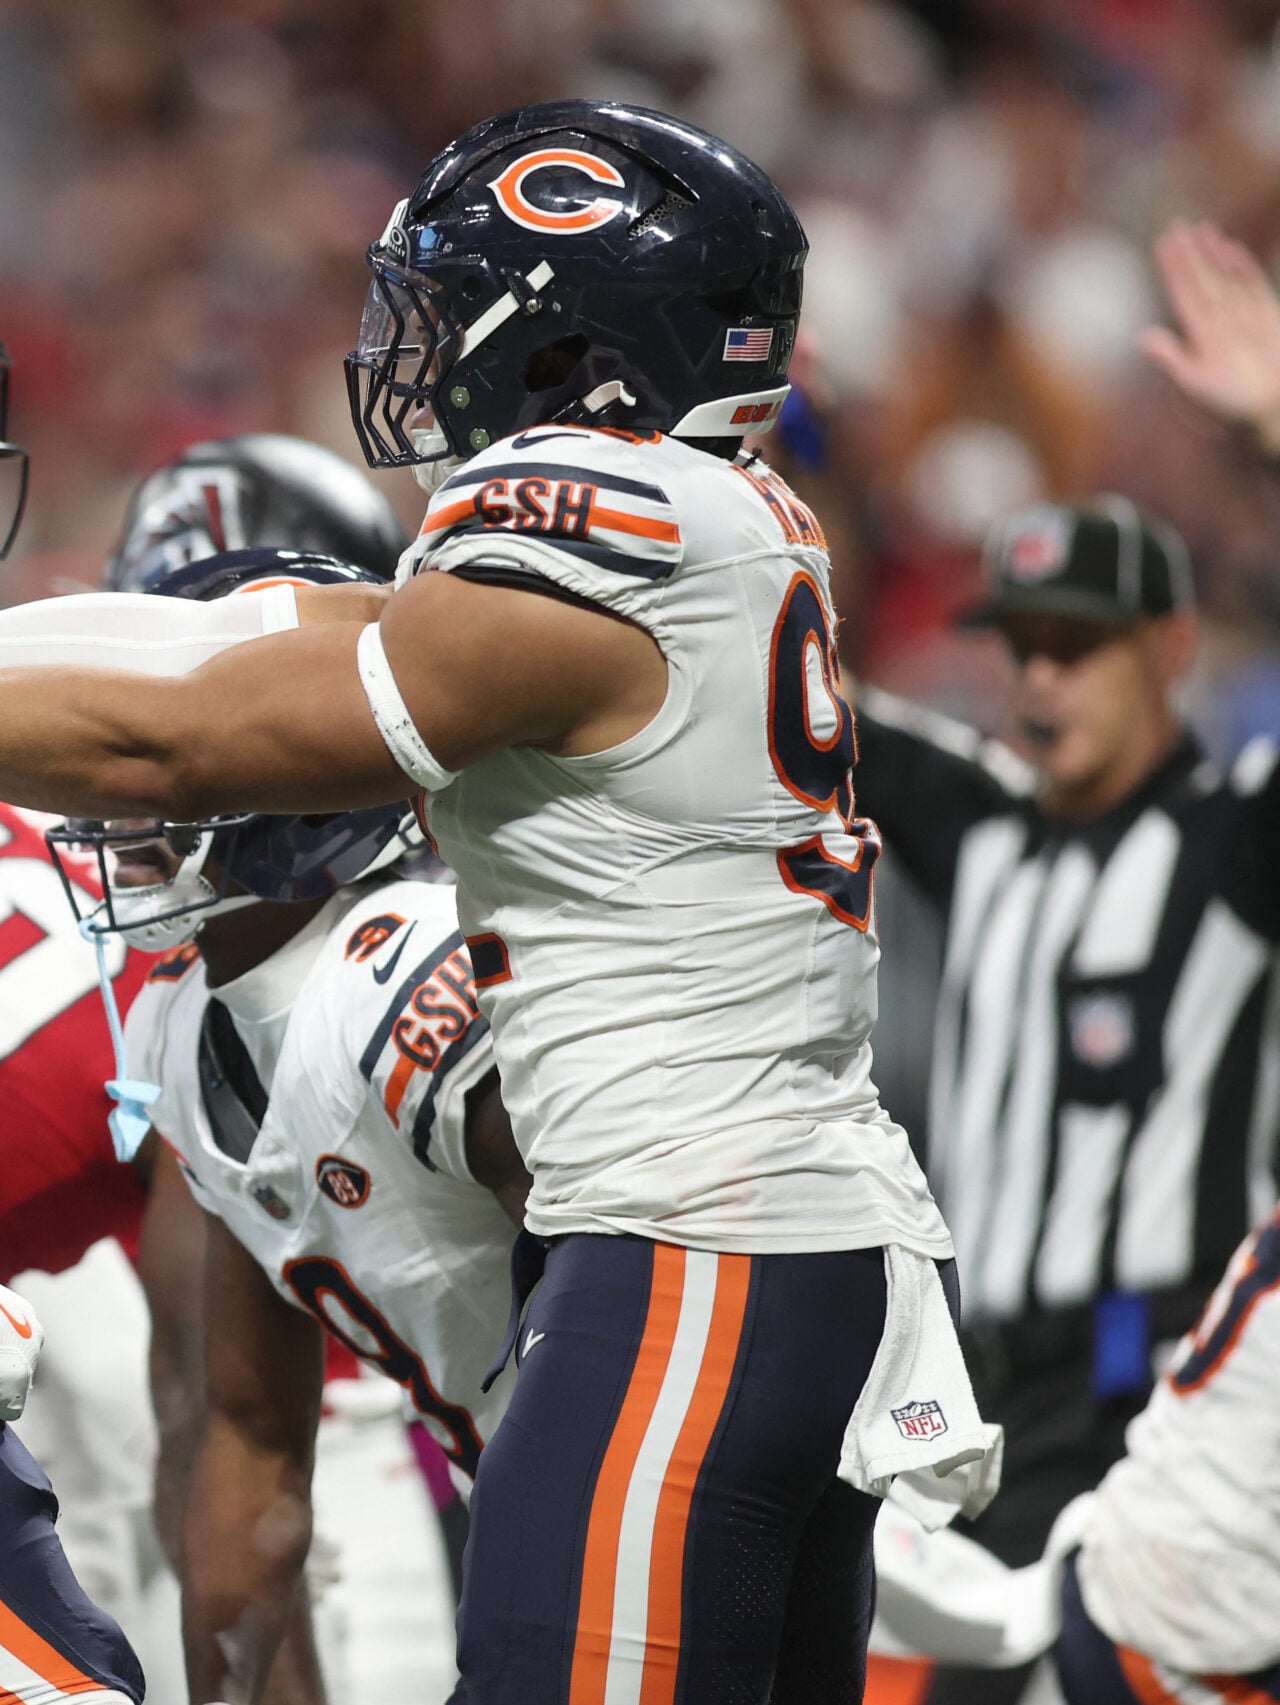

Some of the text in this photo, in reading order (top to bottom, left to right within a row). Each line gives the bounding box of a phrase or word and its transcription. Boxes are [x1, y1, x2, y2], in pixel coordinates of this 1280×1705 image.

[486, 148, 626, 236] C
[474, 477, 598, 541] GSH
[768, 569, 882, 933] 9
[391, 949, 482, 1072] GSH
[901, 1414, 943, 1436] NFL
